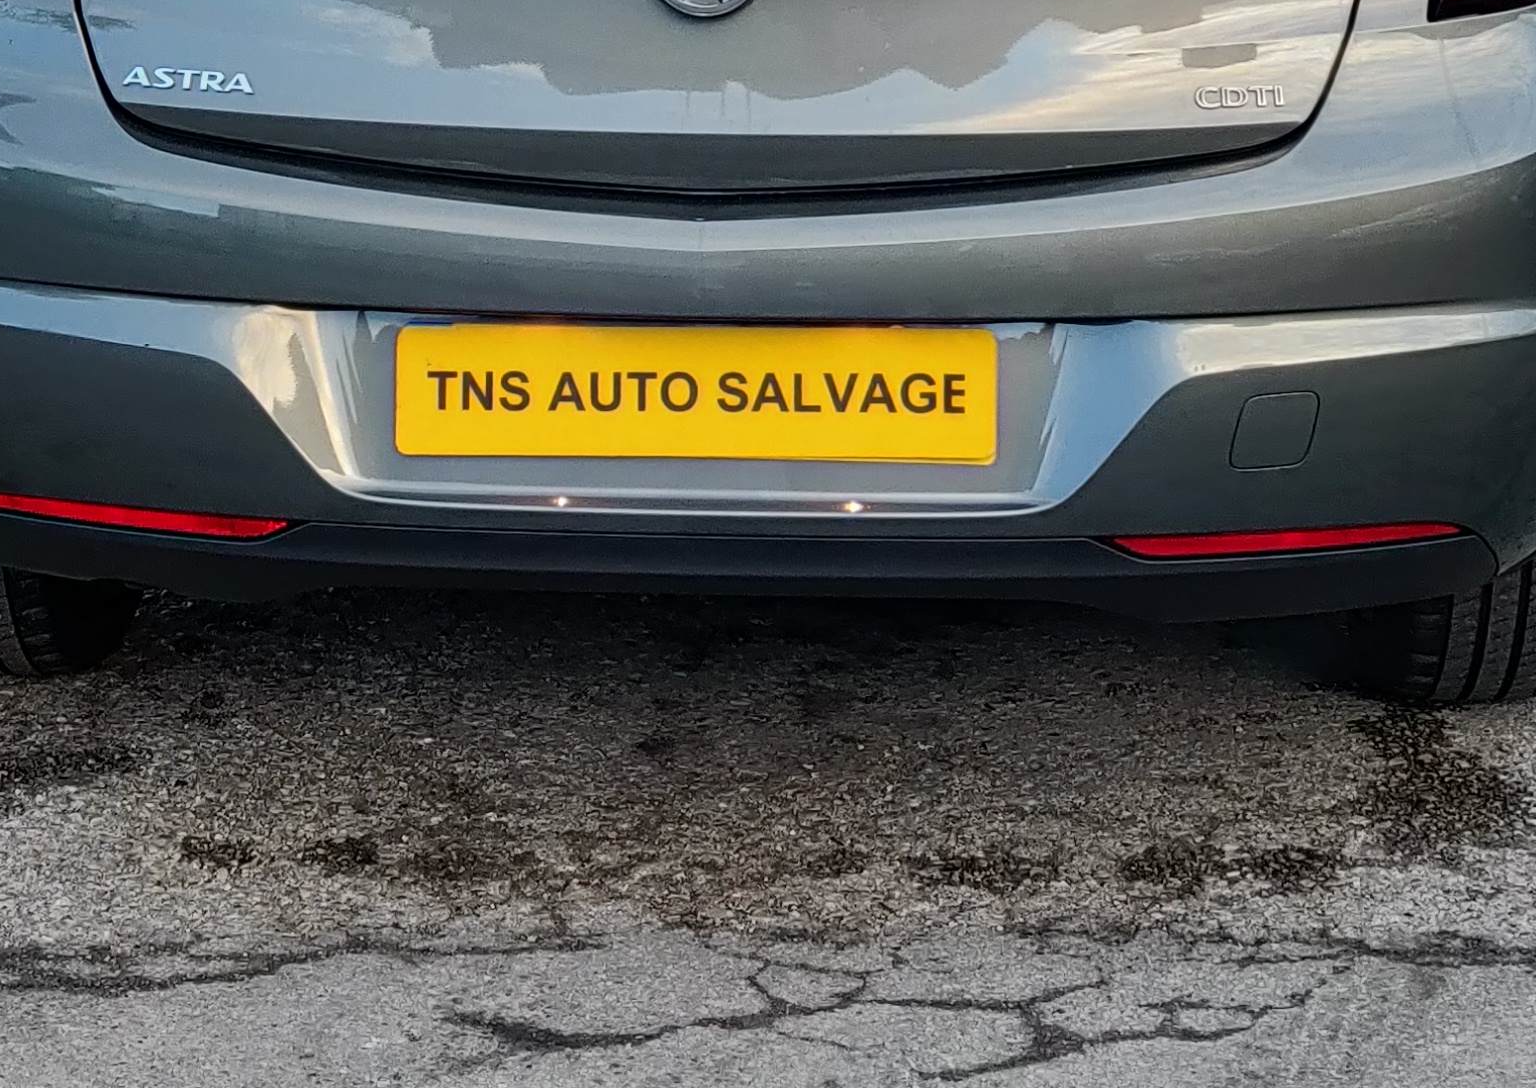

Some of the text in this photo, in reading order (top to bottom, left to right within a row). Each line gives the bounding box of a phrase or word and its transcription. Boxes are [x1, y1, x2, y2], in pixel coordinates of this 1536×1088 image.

[122, 66, 255, 95] ASTRA
[1194, 85, 1286, 110] CDTI
[426, 369, 966, 415] TNS AUTO SALVAGE
